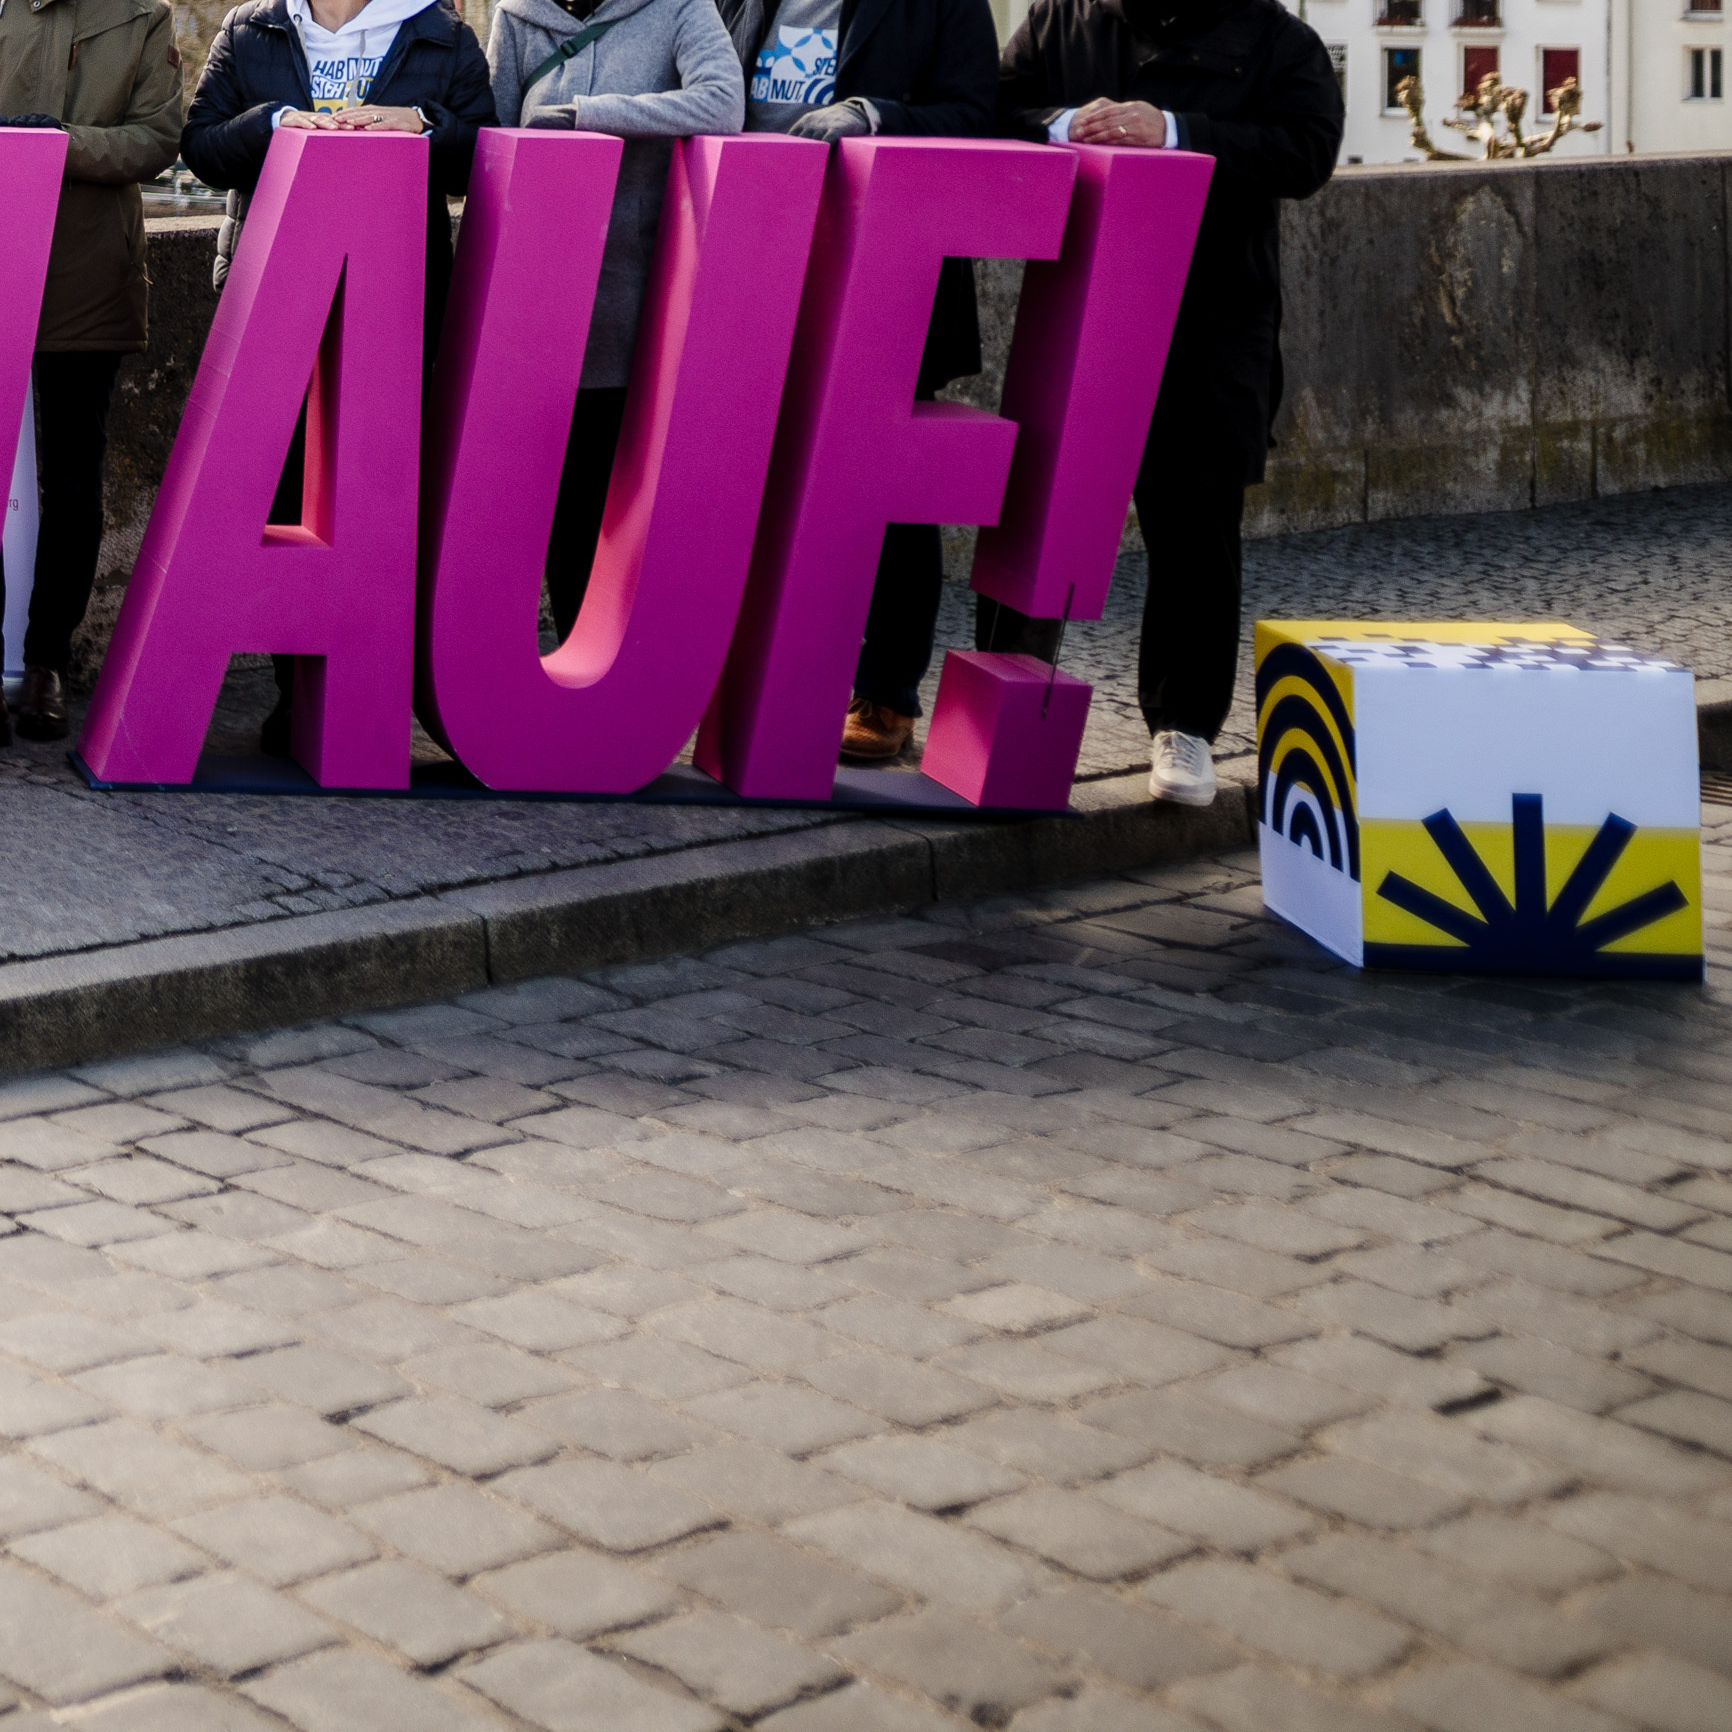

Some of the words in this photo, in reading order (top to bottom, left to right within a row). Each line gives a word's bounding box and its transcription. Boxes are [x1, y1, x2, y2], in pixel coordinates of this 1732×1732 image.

[313, 60, 345, 80] HAB
[813, 57, 836, 76] STE
[311, 76, 344, 99] STEH
[751, 77, 769, 100] AB
[771, 79, 805, 101] MUT,
[77, 127, 1216, 809] AUF!
